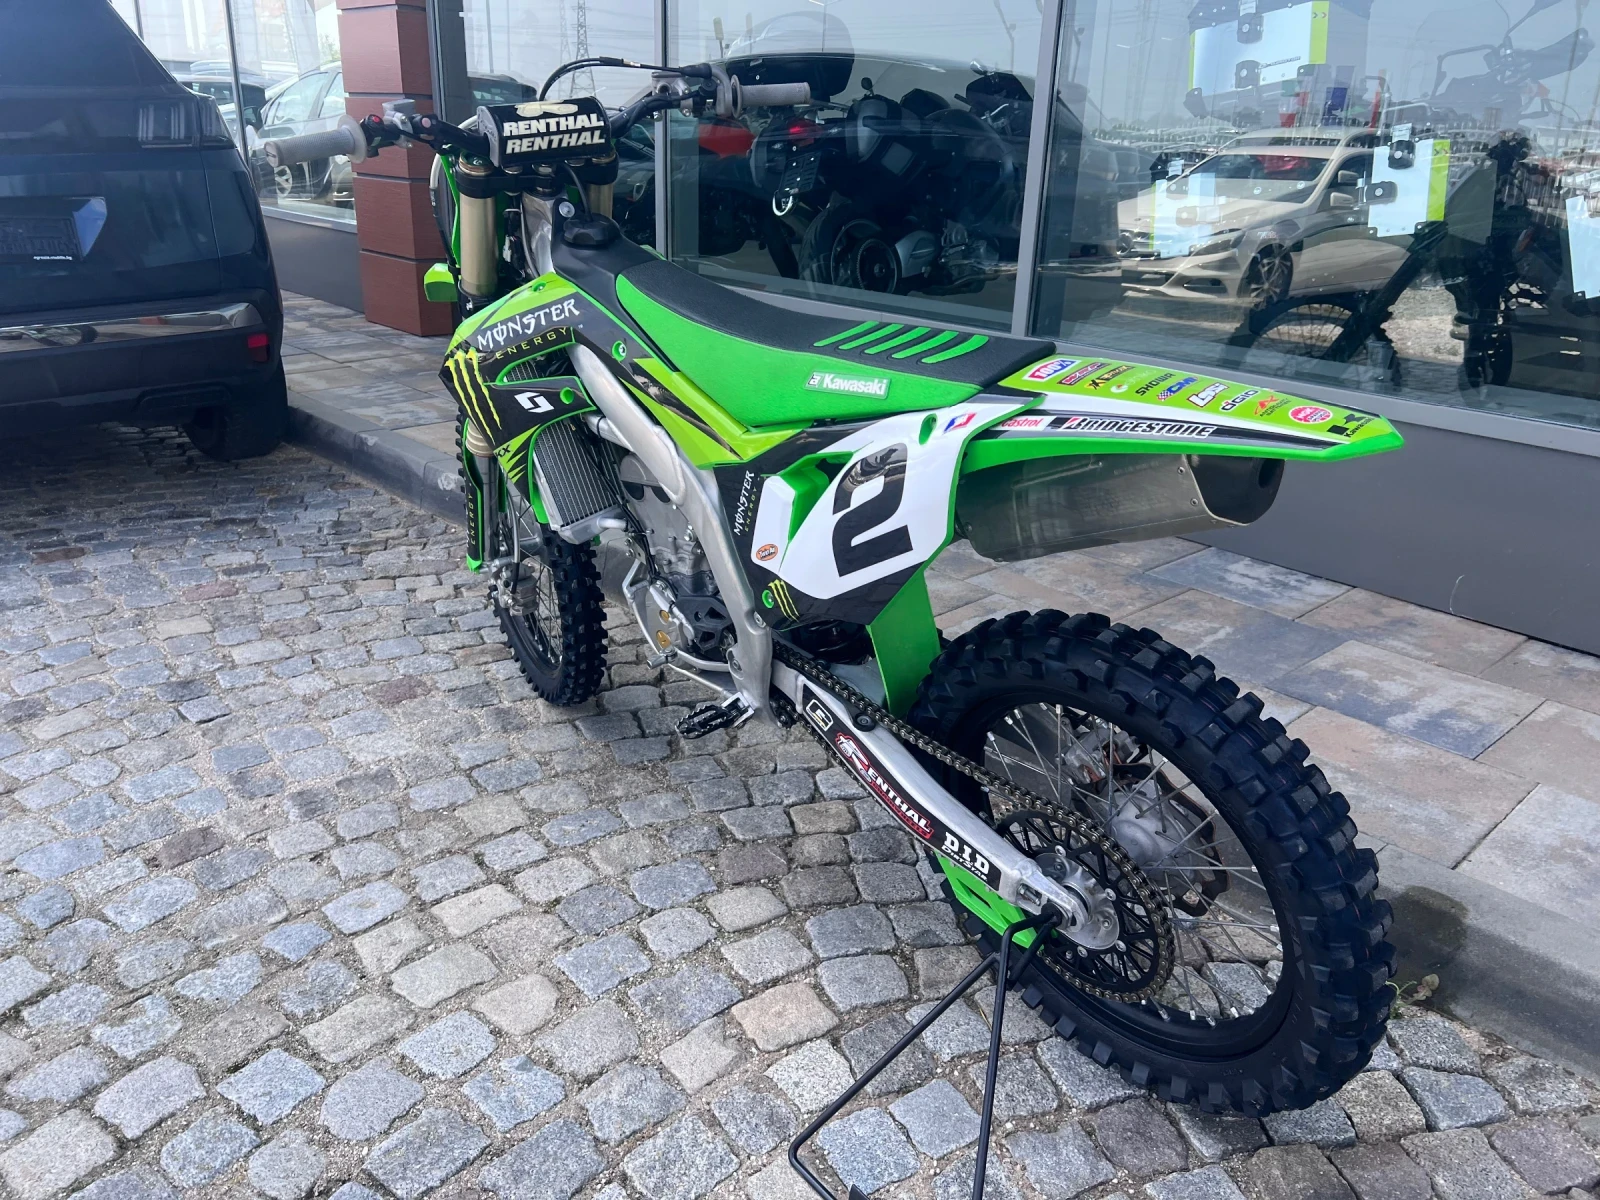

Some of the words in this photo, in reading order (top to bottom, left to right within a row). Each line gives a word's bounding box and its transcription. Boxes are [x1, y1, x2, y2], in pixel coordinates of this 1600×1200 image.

[503, 113, 605, 137] RENTHAL
[505, 130, 606, 154] RENTHAL
[476, 298, 580, 351] MONSTER
[495, 326, 568, 360] ENERGY
[1033, 359, 1072, 378] 100%
[823, 373, 887, 395] Kawasaki
[1135, 372, 1176, 396] SHOWA
[1062, 416, 1216, 438] BRIDGESTONE
[733, 470, 755, 536] MONSTER
[744, 486, 757, 532] ENERGY
[832, 442, 914, 578] 2
[468, 492, 476, 546] ENERGY
